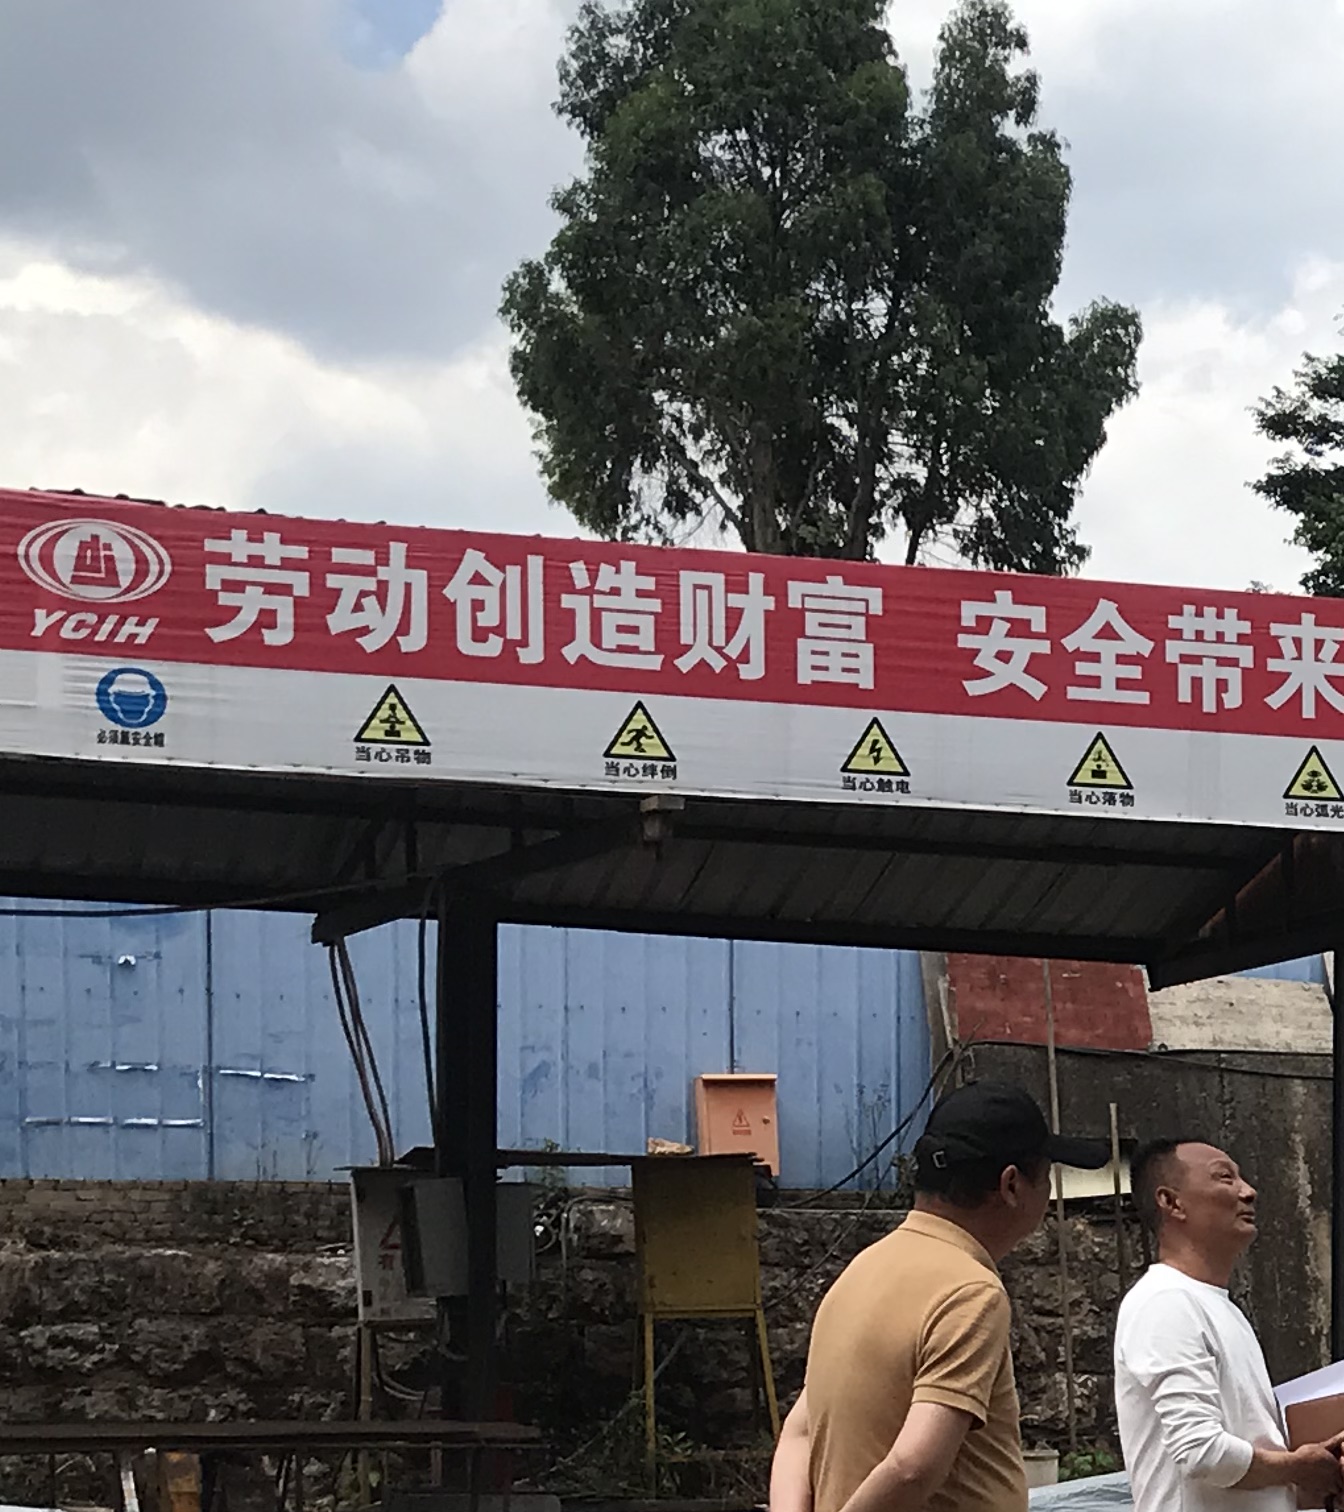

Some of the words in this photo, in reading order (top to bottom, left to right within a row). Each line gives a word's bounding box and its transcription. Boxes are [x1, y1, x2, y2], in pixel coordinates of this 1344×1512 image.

[204, 529, 884, 690] 劳动创造财富
[30, 608, 160, 645] YCIH
[355, 745, 432, 765] 当心吊物
[604, 760, 677, 781] 当心绊倒
[842, 775, 912, 794] 当心触电
[1069, 789, 1135, 807] 当心落物
[1285, 801, 1344, 819] 当心弧光
